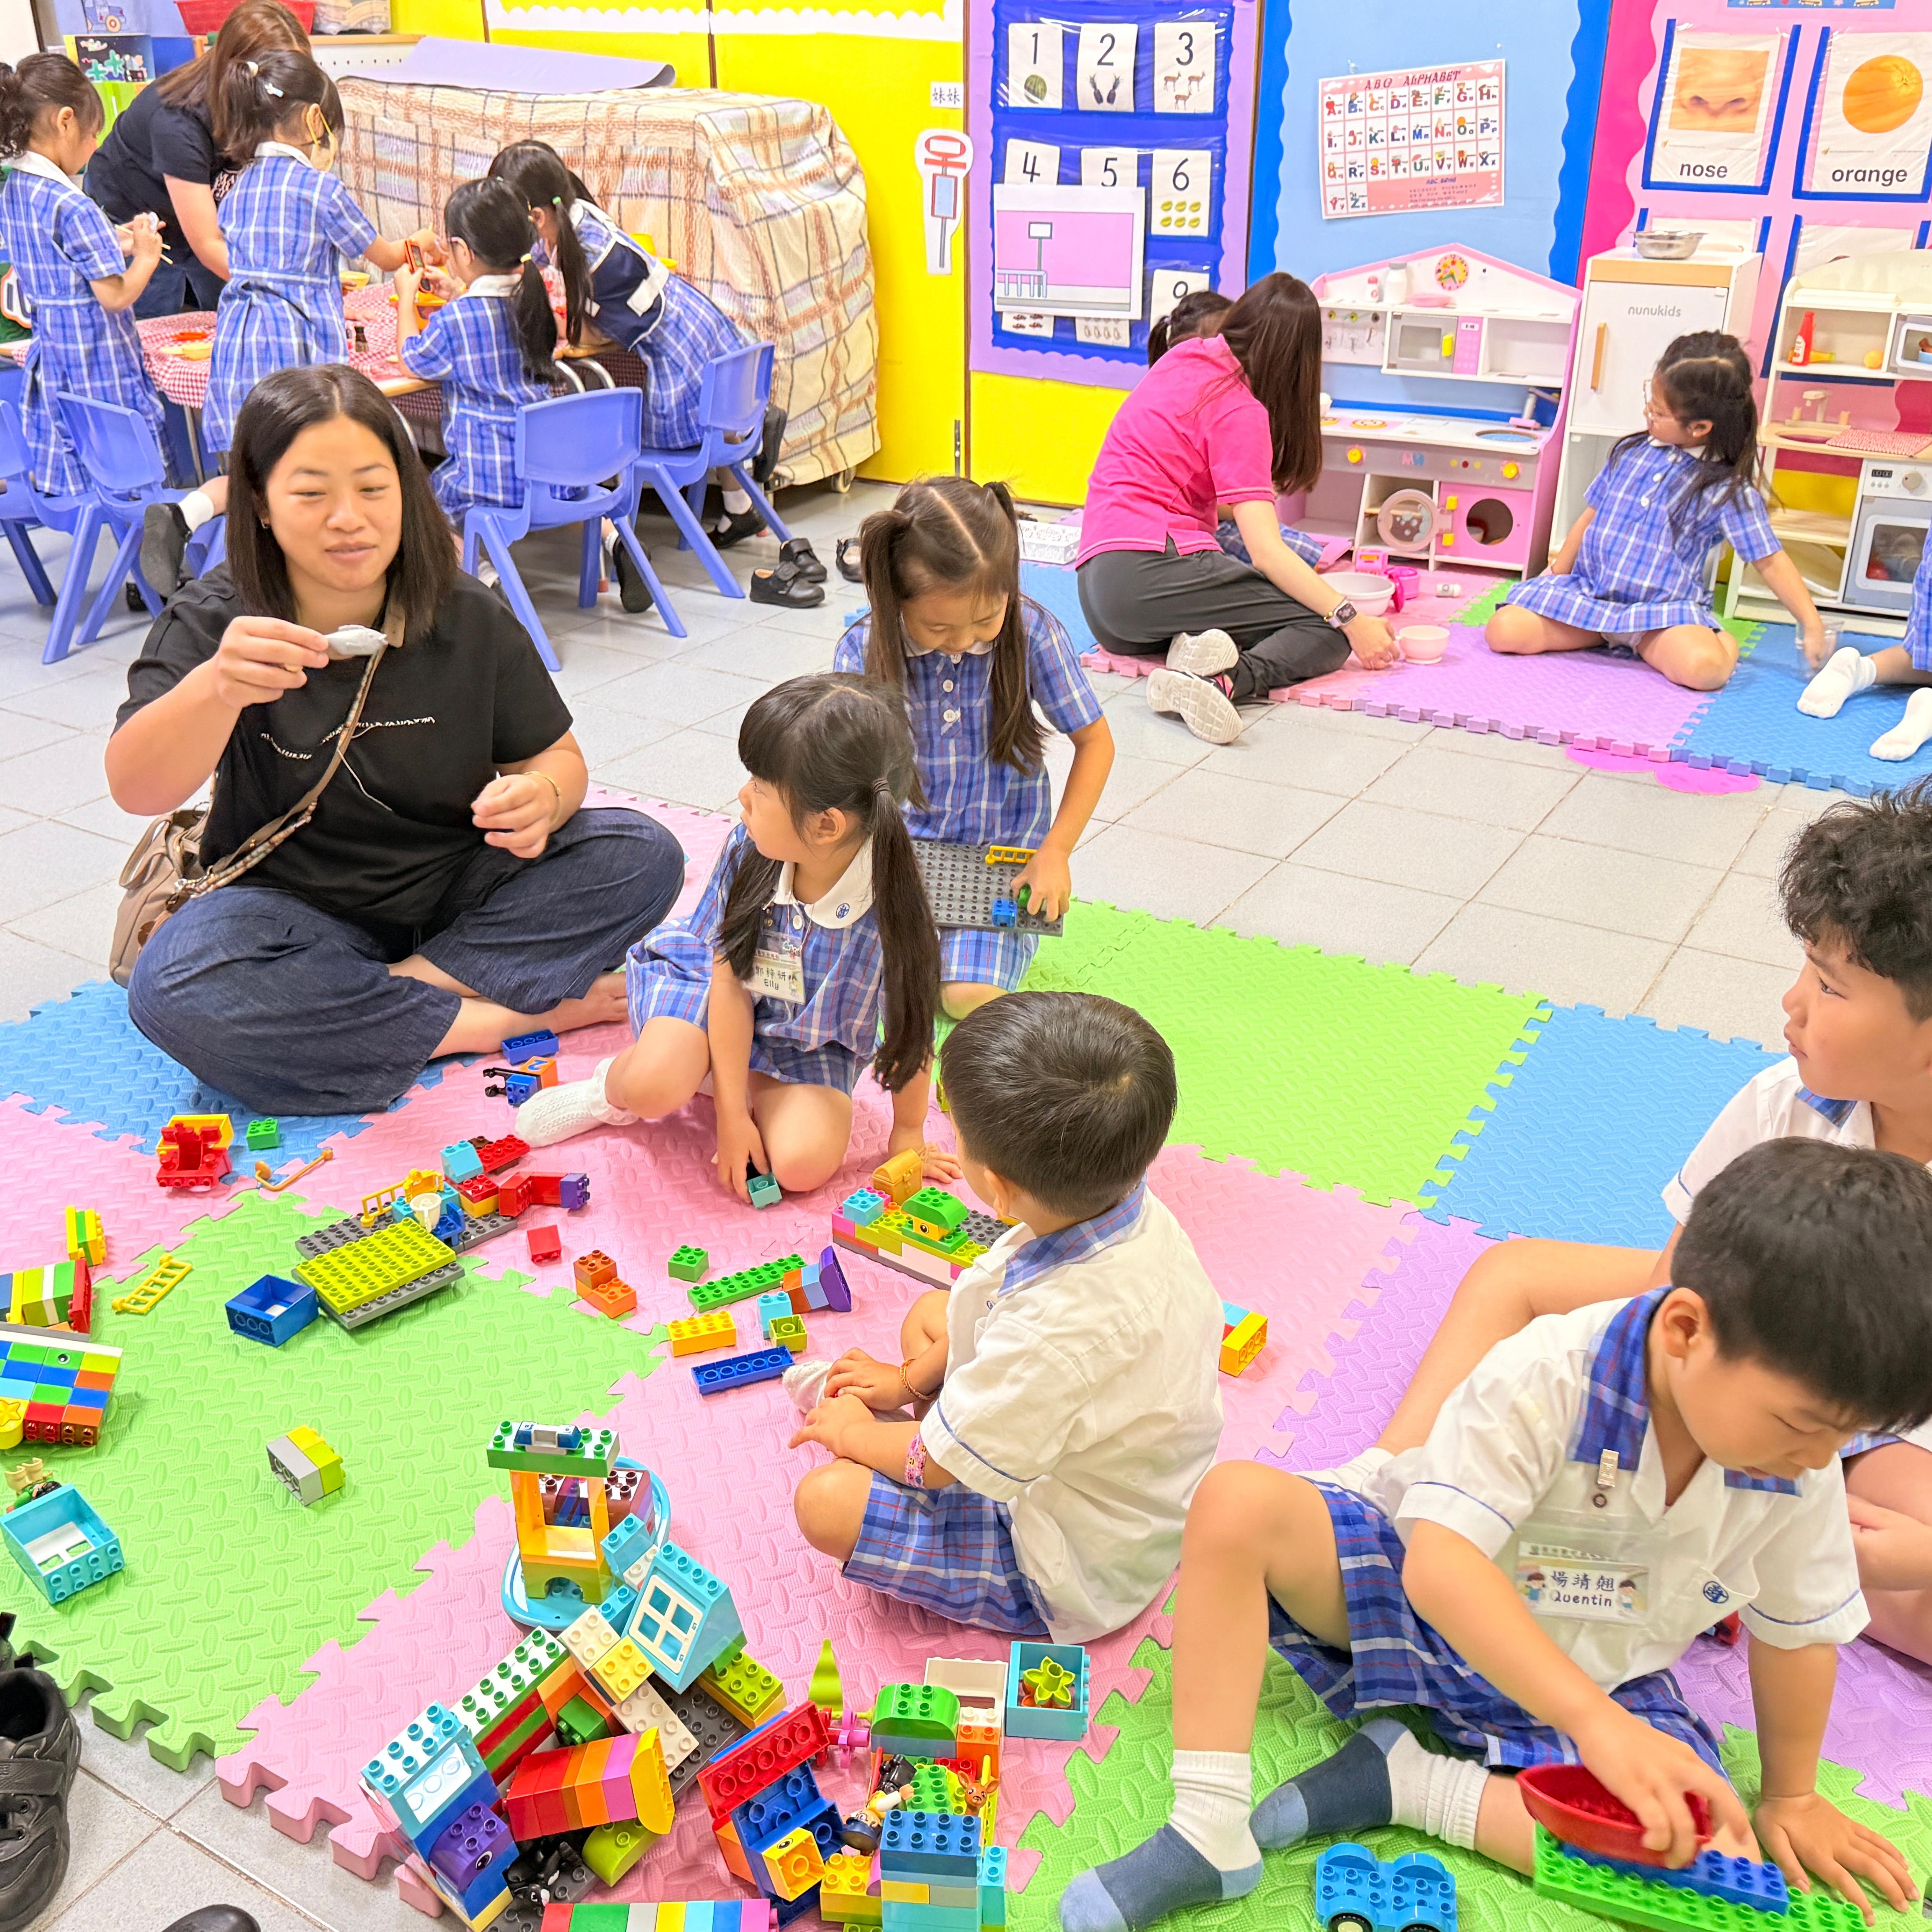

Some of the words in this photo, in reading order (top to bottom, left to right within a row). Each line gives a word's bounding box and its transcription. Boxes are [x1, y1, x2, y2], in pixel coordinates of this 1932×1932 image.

[1032, 32, 1039, 65] 1
[1097, 33, 1116, 66] 2
[1176, 32, 1194, 66] 3
[1402, 69, 1462, 87] ALPHABET
[932, 87, 960, 105] 妹妹
[1023, 152, 1041, 183] 4
[1101, 157, 1118, 187] 5
[1172, 158, 1190, 192] 6
[1679, 163, 1728, 178] nose
[1832, 168, 1908, 187] orange
[1628, 304, 1682, 317] nunukids
[764, 978, 779, 991] Elly
[1550, 1590, 1612, 1607] Quentin
